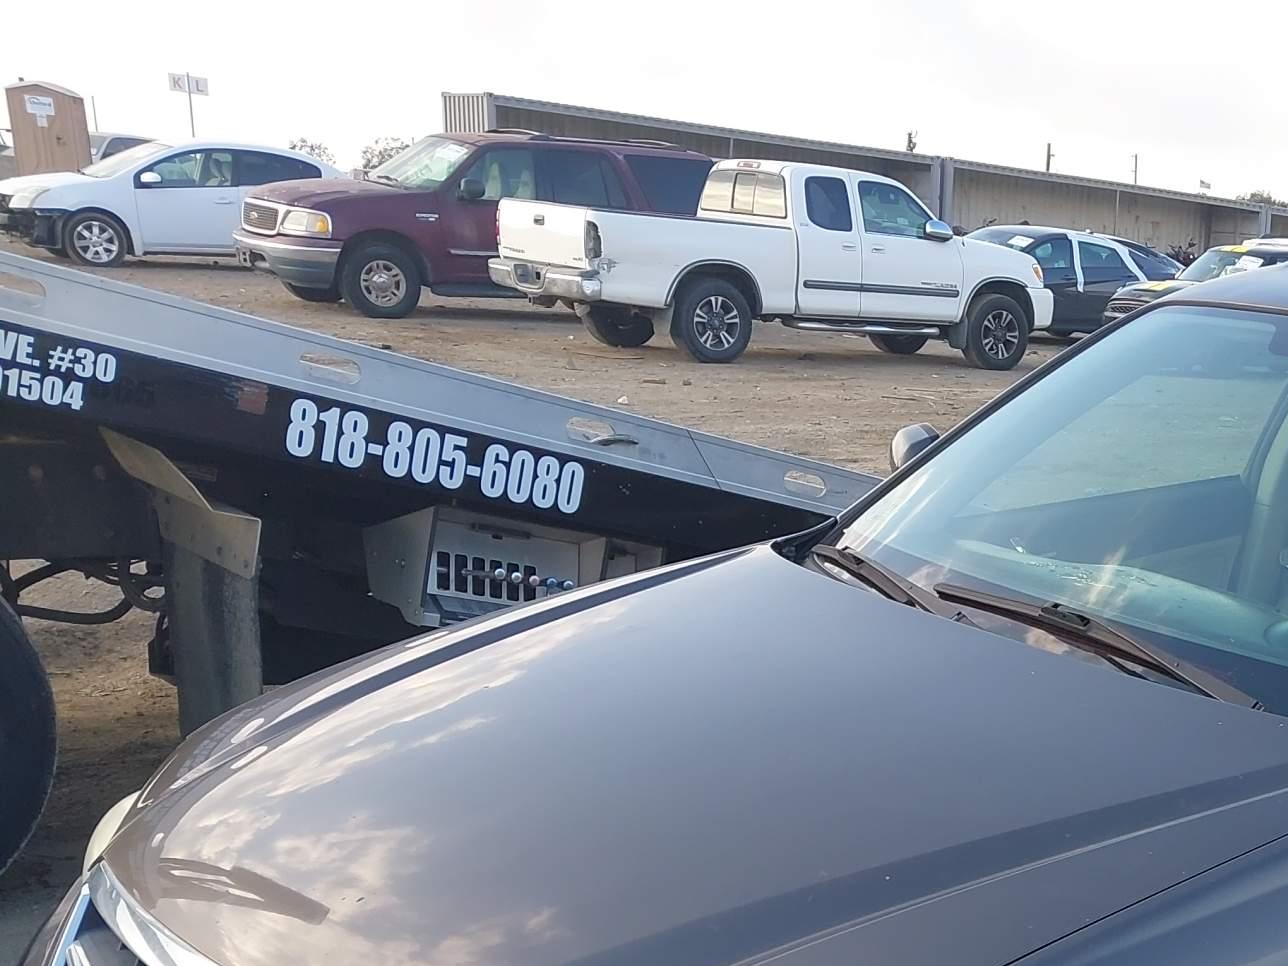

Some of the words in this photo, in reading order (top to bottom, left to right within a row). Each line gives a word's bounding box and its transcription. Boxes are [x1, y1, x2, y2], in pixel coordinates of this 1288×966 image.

[172, 76, 183, 89] K
[196, 79, 205, 93] L
[48, 345, 117, 383] #30
[0, 365, 84, 411] 1504
[285, 398, 585, 514] 818-805-6080
